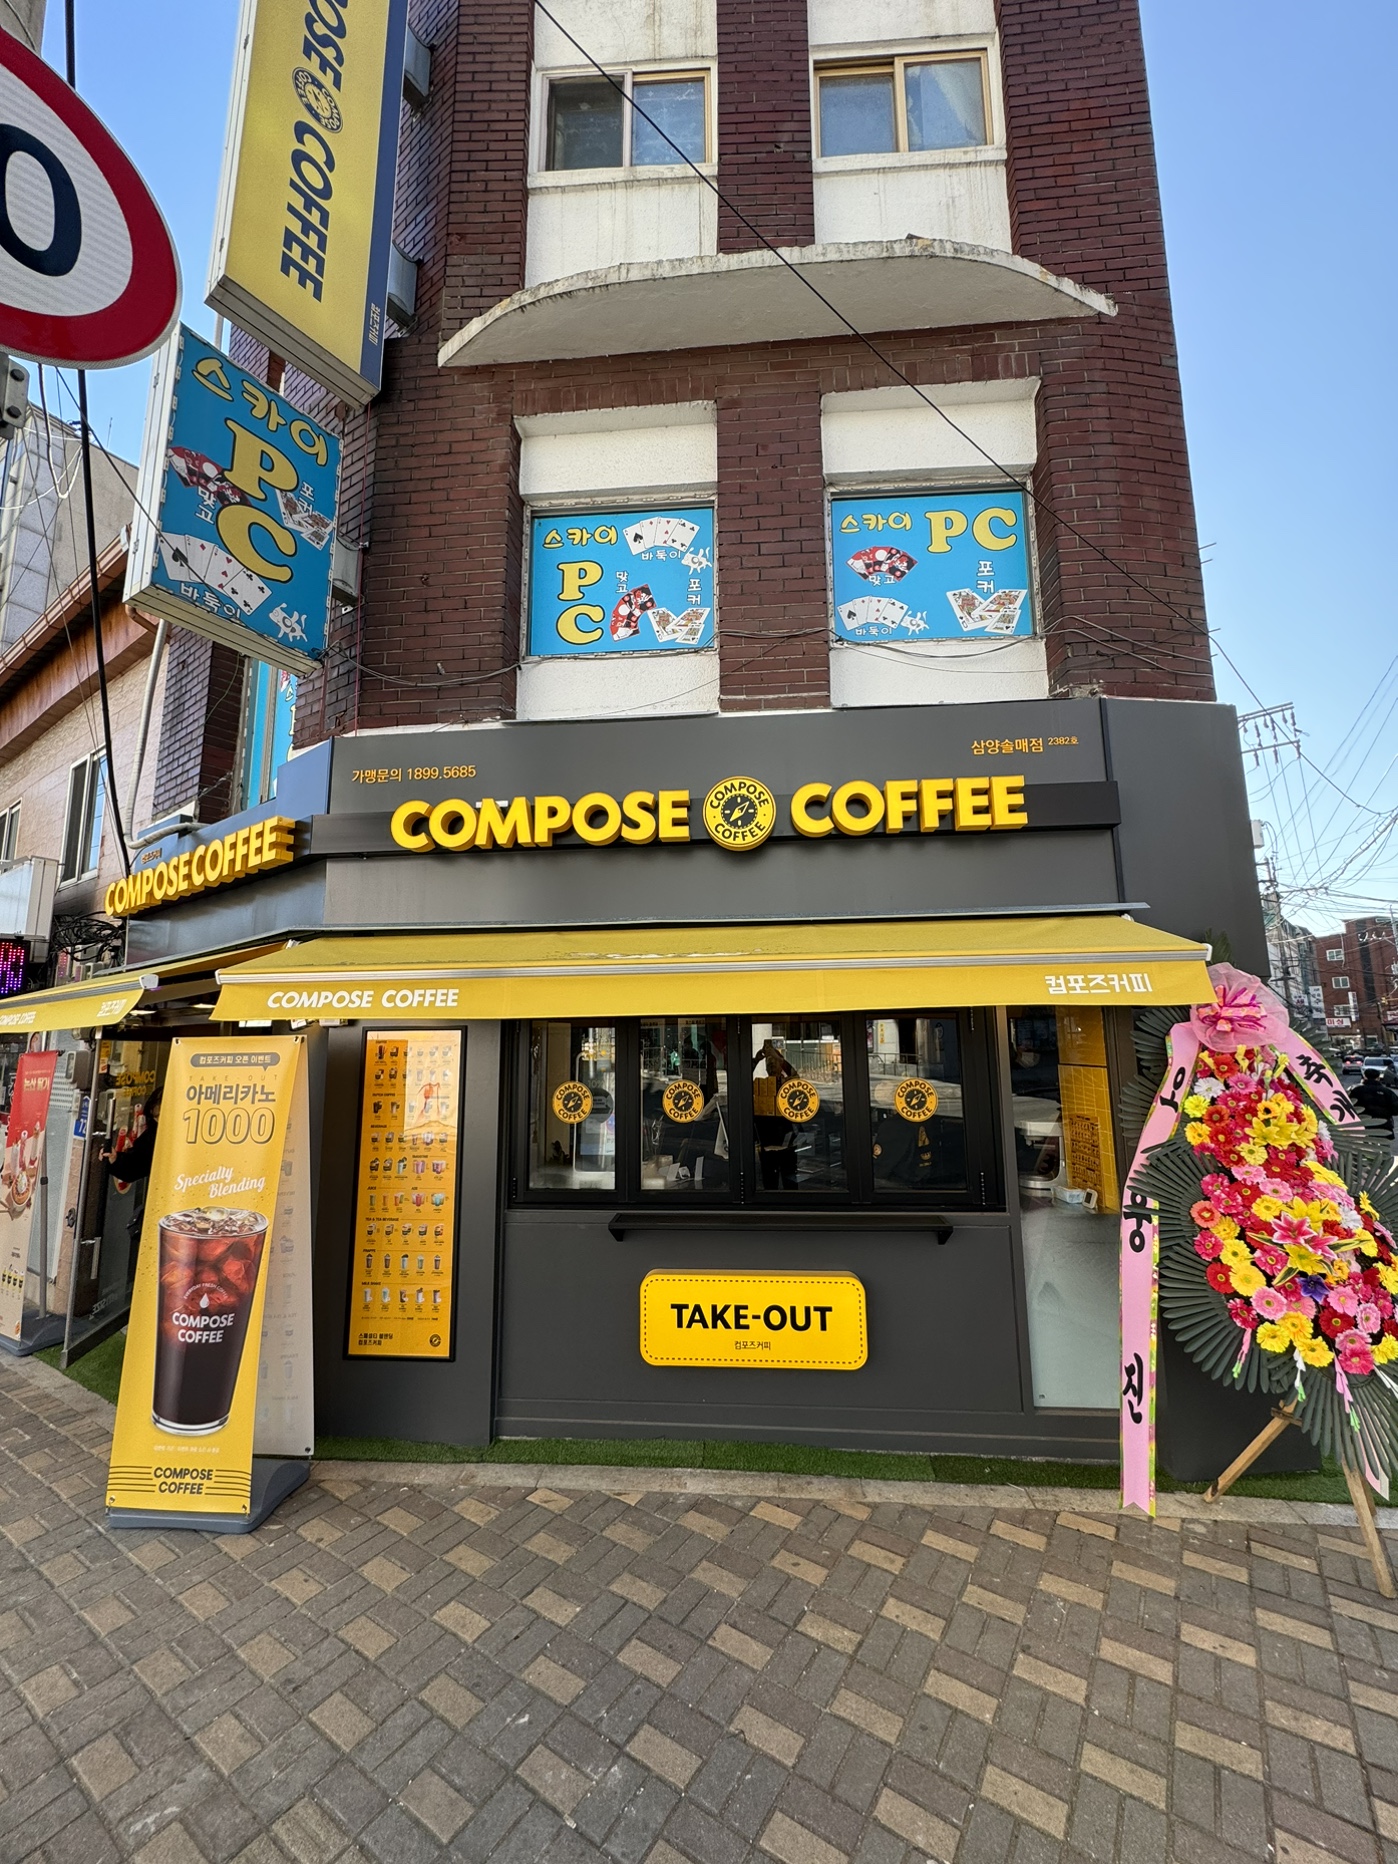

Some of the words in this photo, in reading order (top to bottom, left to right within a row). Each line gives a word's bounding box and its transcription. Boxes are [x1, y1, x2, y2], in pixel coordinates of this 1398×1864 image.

[303, 0, 348, 92] OSE
[295, 71, 312, 105] COFFEE
[319, 88, 340, 129] COMPOSE
[279, 120, 336, 303] COFFEE
[192, 357, 328, 466] 스카이
[195, 485, 216, 524] 맞고
[216, 417, 299, 583] PC
[542, 525, 618, 549] 스카이
[839, 512, 912, 533] 스카이
[924, 507, 1018, 554] PC
[641, 550, 681, 562] 바둑이
[615, 571, 629, 593] 맞고
[868, 575, 896, 586] 맞고
[976, 560, 995, 593] 포커
[179, 582, 242, 620] 바둑이
[556, 560, 606, 645] PC
[687, 578, 702, 606] 포커
[855, 627, 893, 636] 바둑이
[971, 738, 1044, 755] 삼양솔매점
[1047, 736, 1079, 746] 2382호
[351, 766, 402, 784] 가맹문의
[406, 764, 477, 780] 1899.5685
[709, 781, 770, 809] COMPOSE
[390, 789, 690, 853] COMPOSE
[790, 774, 1028, 838] COFFEE
[714, 821, 766, 842] COFFEE
[104, 852, 194, 918] COMPOSE
[191, 815, 296, 888] COFFEE
[1044, 972, 1154, 995] 컴포즈커피
[267, 990, 374, 1008] COMPOSE
[381, 988, 459, 1007] COFFEE
[235, 1055, 249, 1064] 오픈
[250, 1054, 272, 1064] 이벤트
[186, 1083, 276, 1105] 아메리카노
[556, 1084, 590, 1100] COMPOSE
[666, 1083, 700, 1099] COMPOSE
[781, 1081, 816, 1099] COMPOSE
[898, 1081, 934, 1098] COMPOSE
[558, 1108, 587, 1120] COFFEE
[669, 1107, 698, 1119] COFFEE
[784, 1106, 814, 1119] COFFEE
[901, 1106, 932, 1118] COFFEE
[182, 1107, 275, 1145] 1000
[208, 1176, 266, 1199] Blending
[172, 1312, 235, 1329] COMPOSE
[670, 1303, 832, 1331] TAKE-OUT
[177, 1328, 224, 1343] COFFEE
[734, 1341, 771, 1350] 컴포즈커피
[153, 1466, 214, 1481] COMPOSE
[158, 1481, 204, 1495] COFFEE
